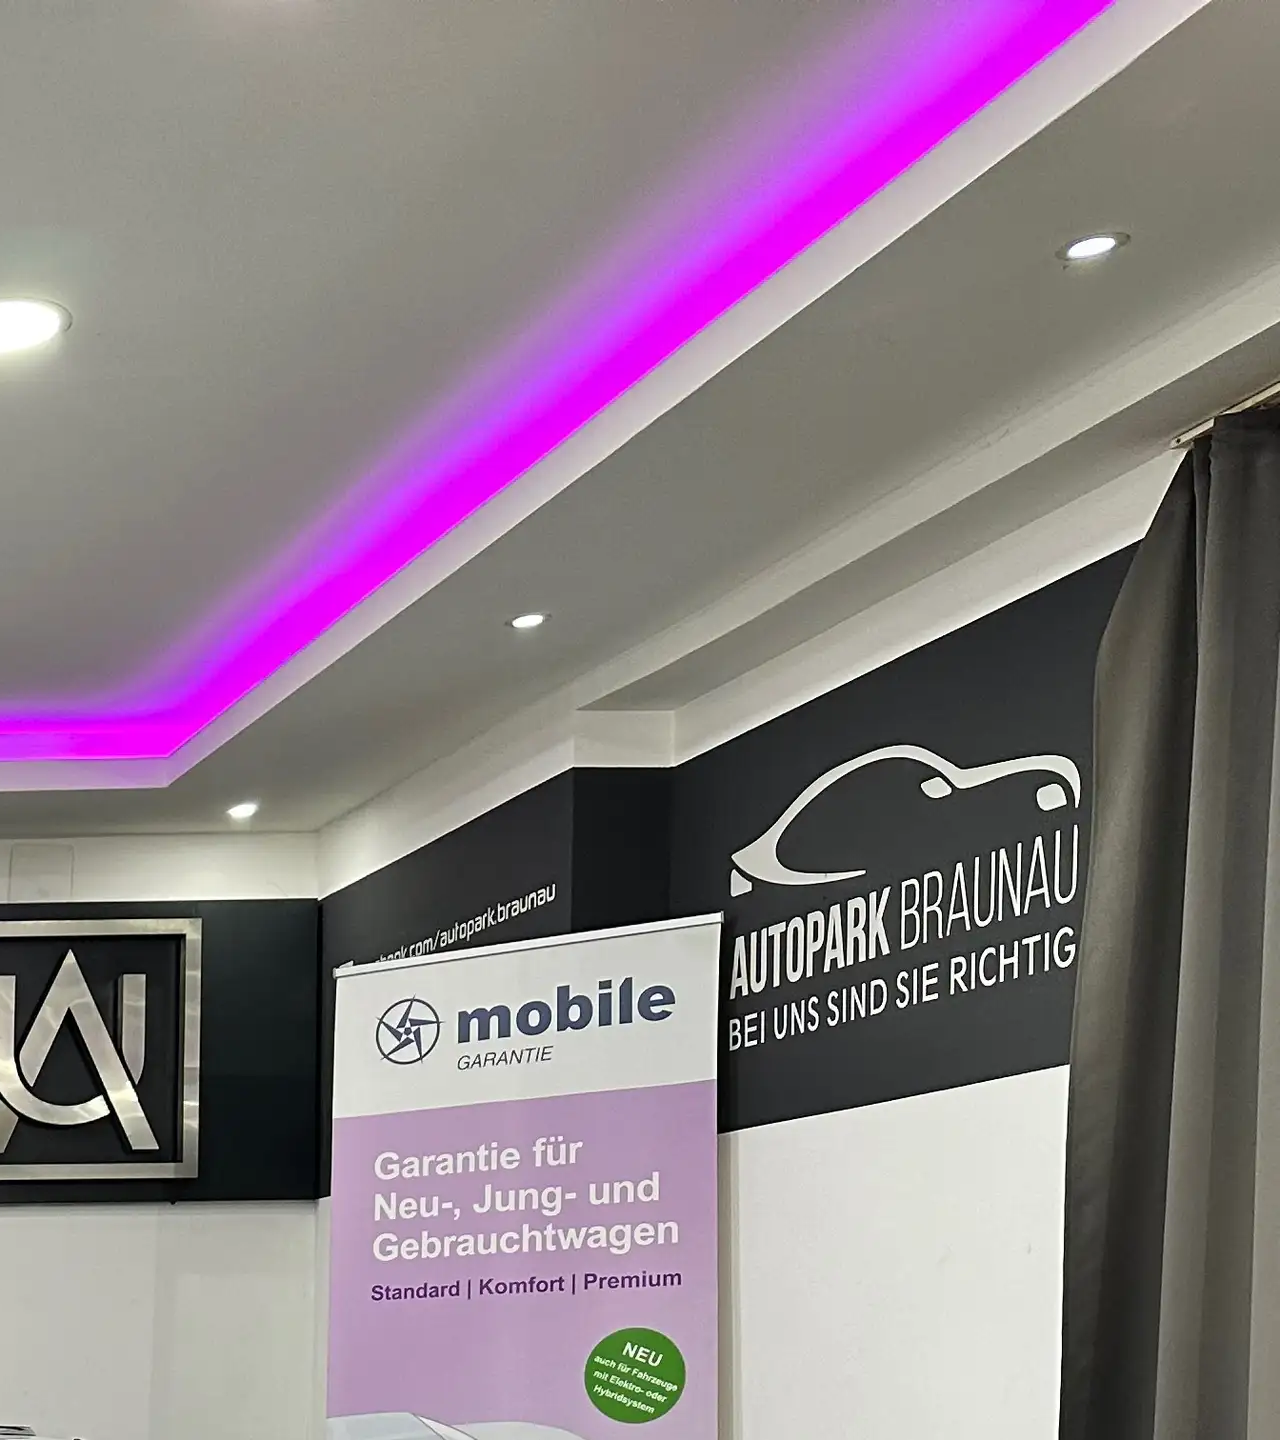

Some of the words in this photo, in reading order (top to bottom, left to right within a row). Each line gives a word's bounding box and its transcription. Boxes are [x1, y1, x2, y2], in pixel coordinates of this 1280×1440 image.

[730, 887, 891, 1000] AUTOPARK
[900, 824, 1079, 950] BRAUNAU
[729, 1010, 766, 1052] BEI
[773, 995, 820, 1041] UNS
[826, 978, 887, 1028] SIND
[896, 962, 940, 1010] SIE
[949, 926, 1076, 996] RICHTIG
[457, 976, 676, 1044] mobile
[457, 1045, 554, 1071] GARANTIE
[374, 1141, 520, 1180] Garantie
[532, 1135, 583, 1168] für
[374, 1192, 461, 1221] Neu-,
[473, 1184, 577, 1216] Jung-
[589, 1171, 660, 1206] und
[372, 1220, 679, 1262] Gebrauchtwagen
[371, 1280, 460, 1301] Standard
[478, 1276, 565, 1296] Komfort
[584, 1271, 682, 1291] Premium
[594, 1355, 616, 1368] auch
[617, 1363, 631, 1373] für
[631, 1368, 678, 1391] Fahrzeuge
[622, 1342, 663, 1367] NEU
[593, 1370, 609, 1381] mit
[609, 1375, 644, 1393] Elektro-
[645, 1390, 667, 1403] oder
[593, 1385, 655, 1414] Hybridsystem
